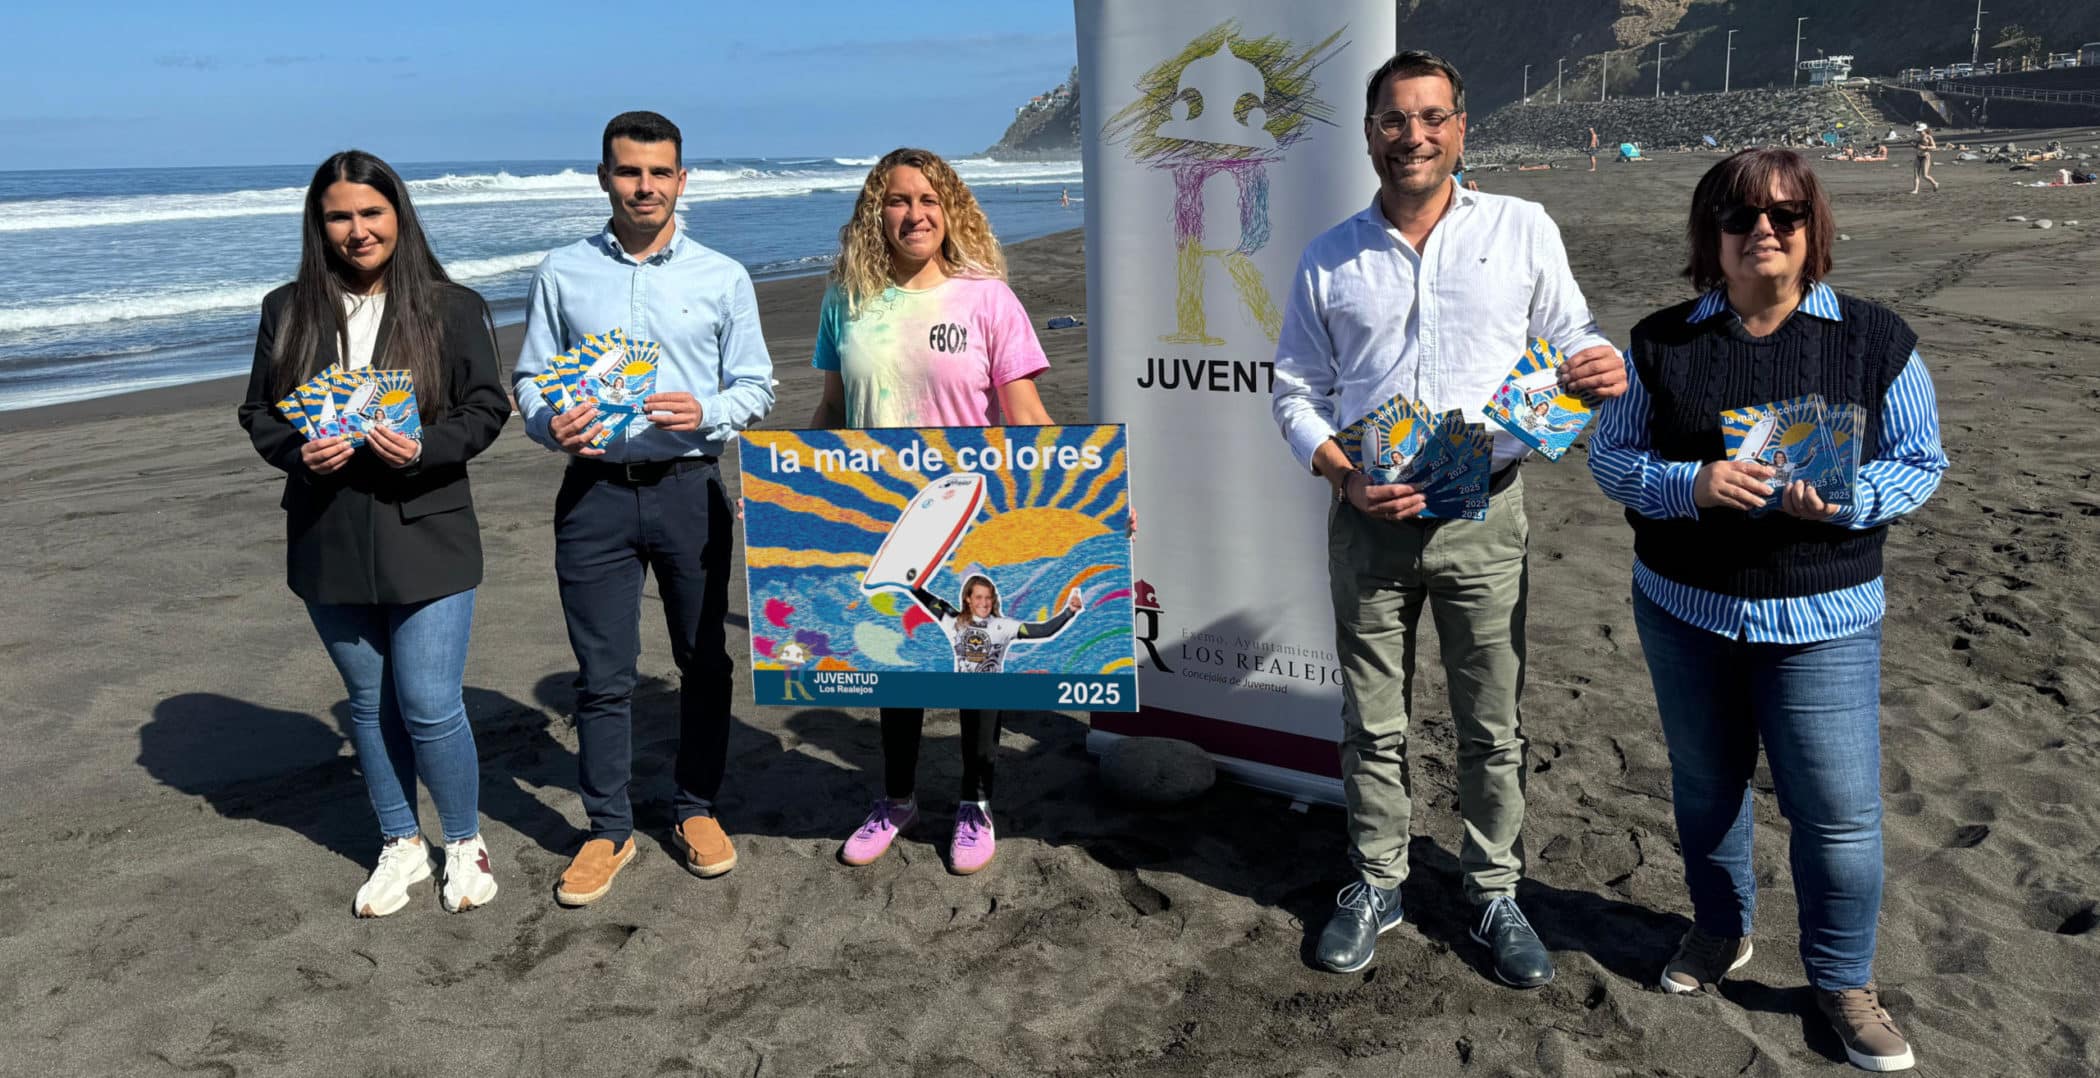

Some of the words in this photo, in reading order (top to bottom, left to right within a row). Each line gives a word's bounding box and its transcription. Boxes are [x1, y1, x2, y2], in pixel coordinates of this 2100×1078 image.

[929, 323, 967, 354] FBOX
[1137, 358, 1275, 393] JUVENT
[1723, 416, 1735, 425] la
[1737, 413, 1758, 423] mar
[1761, 408, 1775, 418] de
[1777, 400, 1816, 415] colores
[1827, 410, 1854, 419] lores
[770, 442, 800, 473] la
[814, 446, 887, 472] mar
[898, 440, 944, 472] de
[957, 438, 1103, 471] colores
[1537, 445, 1558, 460] 2025
[1429, 455, 1449, 470] 2025
[1447, 463, 1468, 480] 2025
[1459, 483, 1480, 494] 2025
[1828, 490, 1850, 500] 2025
[1234, 636, 1334, 662] Ayuntamiento
[1181, 643, 1225, 666] LOS
[1236, 653, 1344, 686] REALEJO
[813, 671, 879, 685] JUVENTUD
[1229, 673, 1242, 686] de
[1243, 676, 1288, 694] Juventud
[819, 685, 836, 693] Los
[837, 685, 874, 695] Realejos
[1057, 681, 1121, 704] 2025
